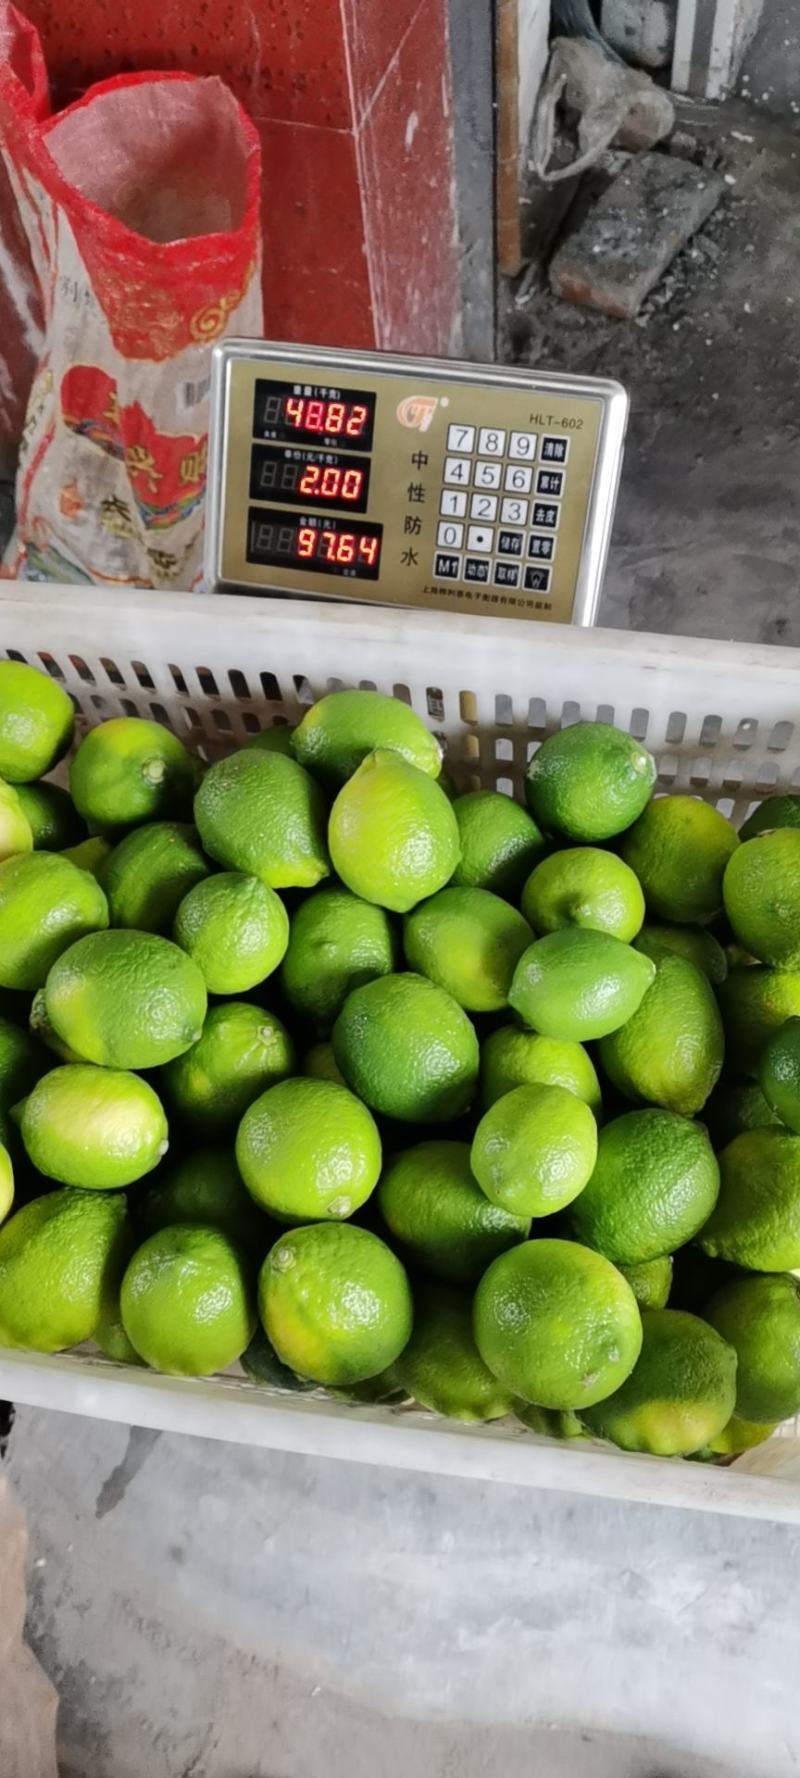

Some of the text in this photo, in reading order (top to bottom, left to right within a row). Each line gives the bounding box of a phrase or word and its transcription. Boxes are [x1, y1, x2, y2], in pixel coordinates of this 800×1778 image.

[286, 398, 367, 435] 48.82
[529, 413, 584, 430] HLT-602
[455, 428, 530, 456] 7 8 9
[301, 466, 362, 499] 2.00
[450, 463, 526, 489] 4 5 6
[401, 450, 429, 567] 中性防水
[449, 495, 521, 521] 1 2 3
[298, 528, 378, 565] 97.64
[443, 527, 457, 545] 0
[438, 558, 458, 574] M1
